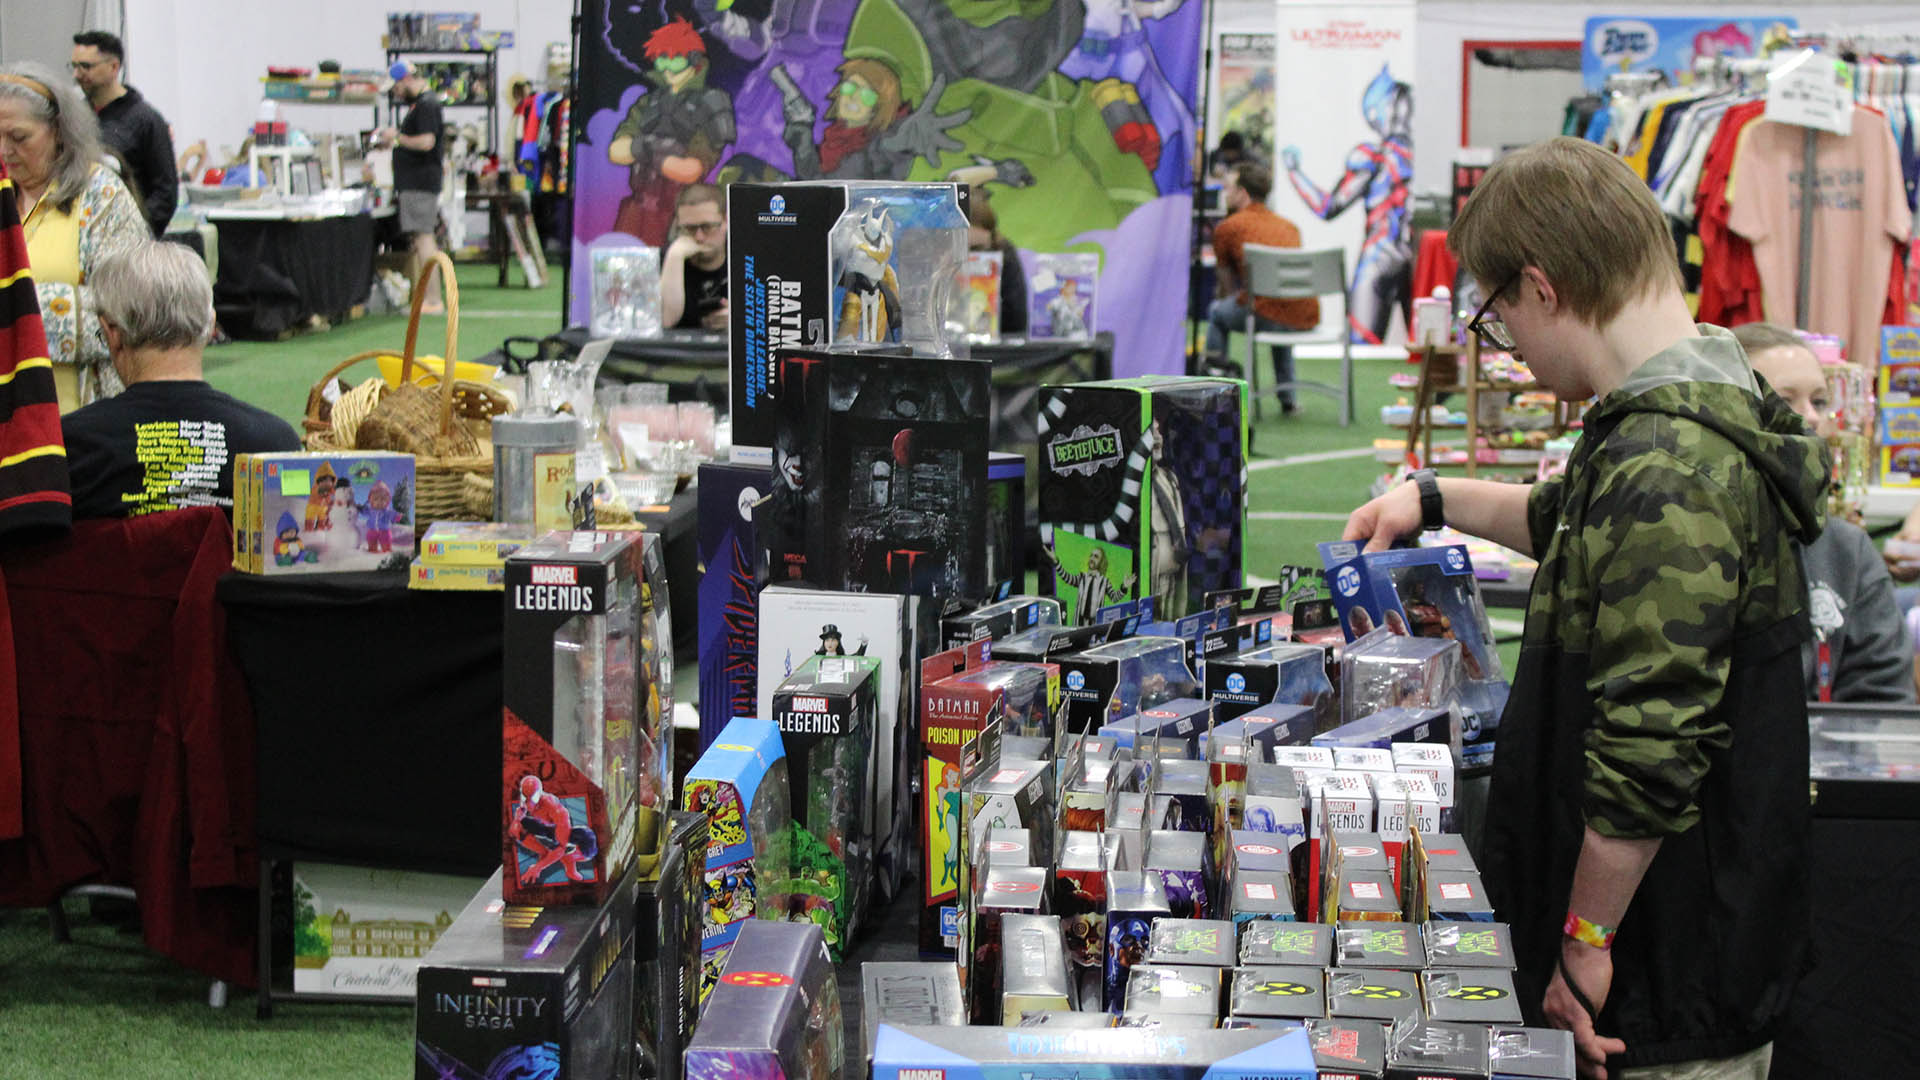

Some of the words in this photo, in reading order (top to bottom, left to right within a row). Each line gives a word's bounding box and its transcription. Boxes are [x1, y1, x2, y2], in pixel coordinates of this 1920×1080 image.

[758, 214, 797, 224] MULTIVERSE
[744, 256, 755, 281] THE
[744, 283, 755, 329] SIXTH
[755, 278, 766, 337] JUSTICE
[744, 332, 756, 408] DIMENSION
[755, 339, 766, 396] LEAGUE:
[180, 420, 201, 431] New
[203, 421, 225, 432] York
[180, 430, 201, 438] New
[203, 430, 225, 439] York
[190, 438, 226, 447] Indiana
[205, 448, 228, 456] Ohio
[1055, 438, 1116, 462] BEETLEJUICE
[204, 456, 228, 465] Ohio
[533, 566, 577, 584] MARVEL
[515, 585, 593, 612] LEGENDS
[1060, 690, 1099, 700] ULTIVERSE
[1213, 692, 1259, 703] MULTIVERSE
[793, 698, 828, 712] MARVEL
[928, 697, 979, 714] BATMAN
[780, 712, 840, 733] LEGENDS
[928, 727, 960, 744] POISON
[1317, 814, 1365, 830] LGENDS
[1383, 816, 1432, 832] LEGDS
[707, 846, 724, 858] GREY
[434, 993, 547, 1016] INFINITY
[466, 1015, 515, 1029] SAGA
